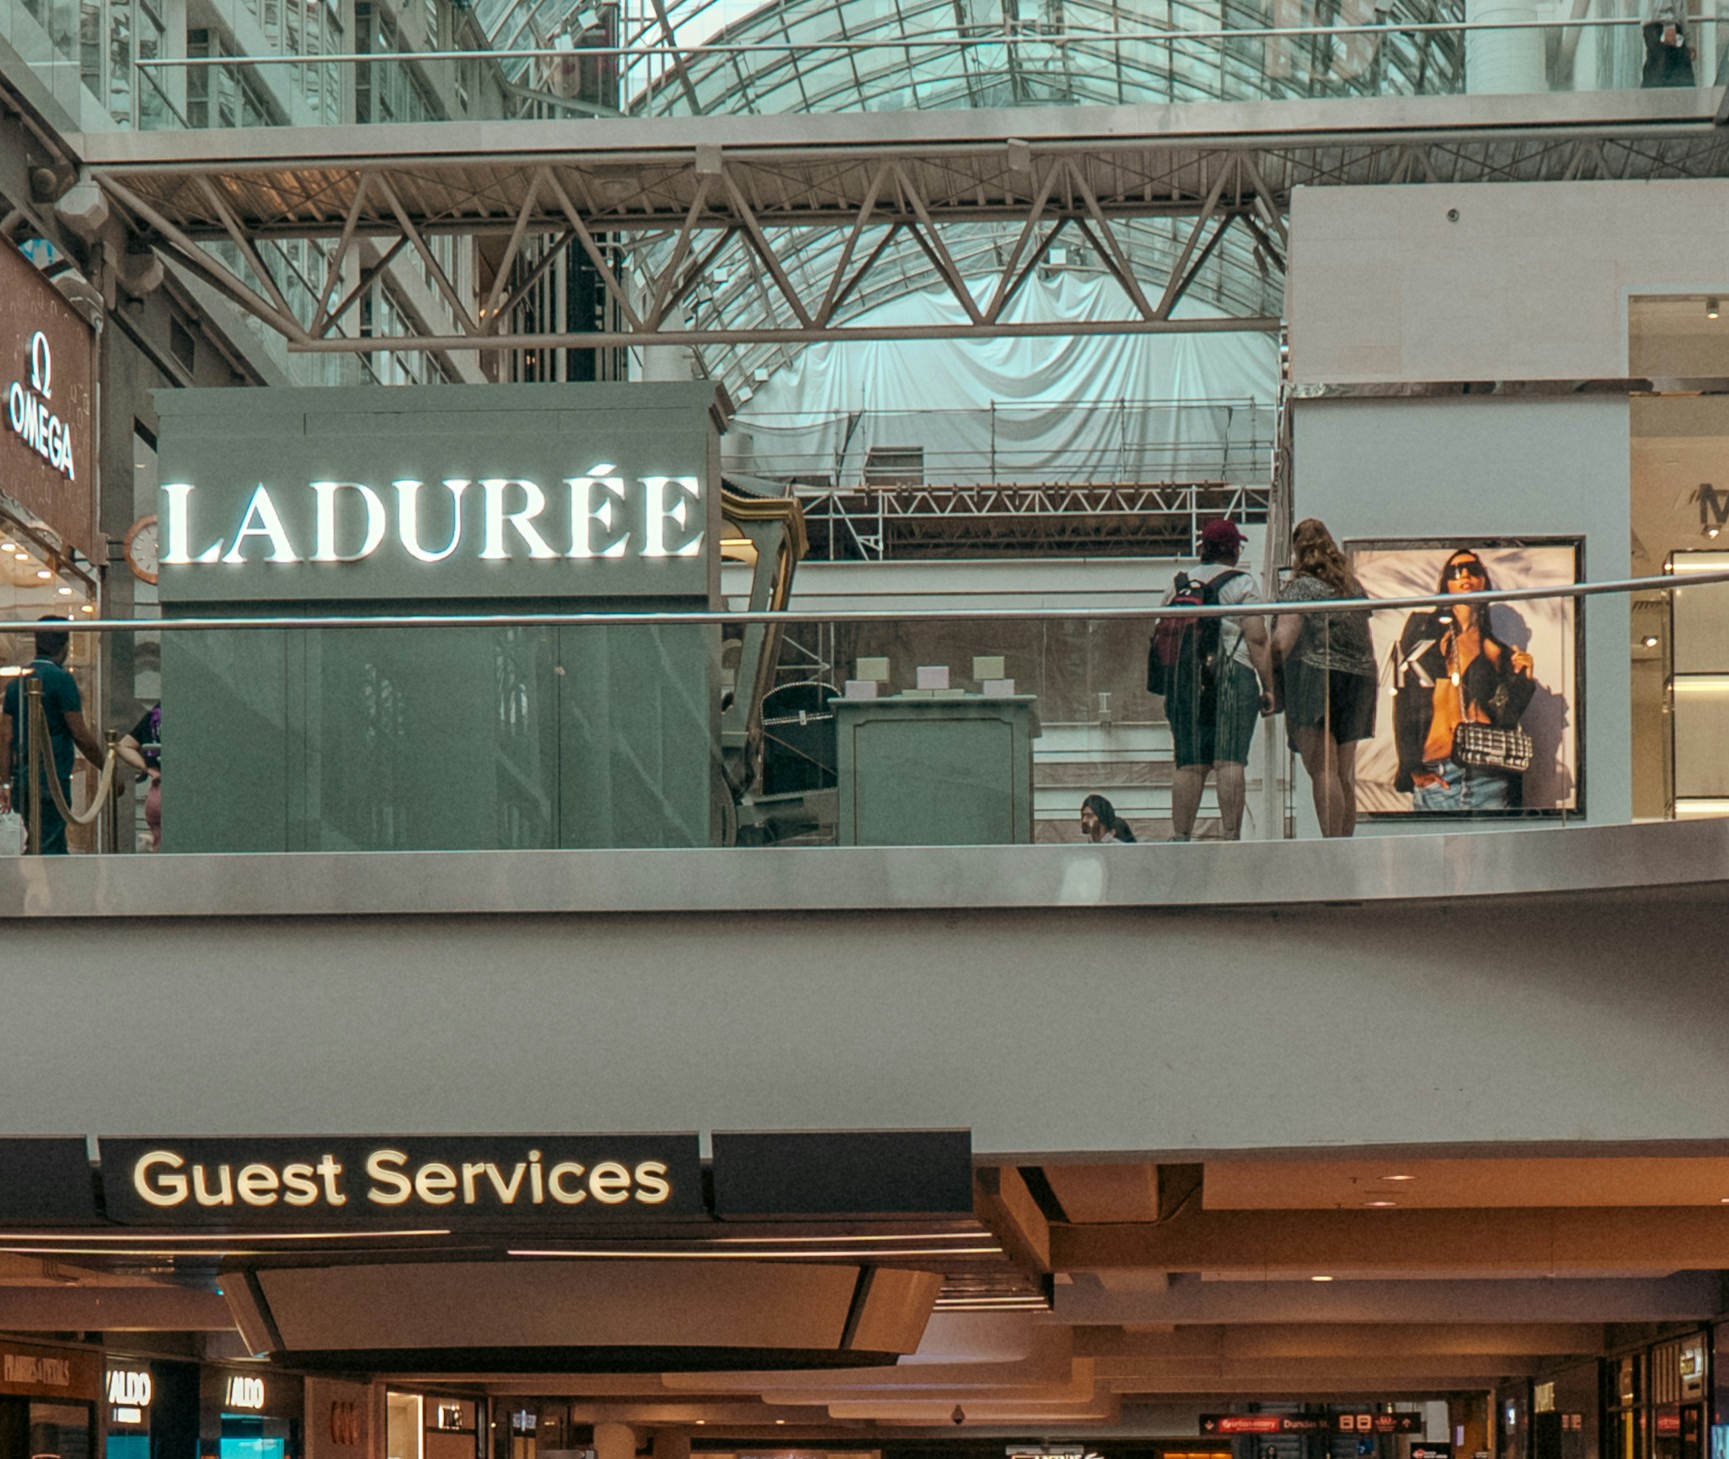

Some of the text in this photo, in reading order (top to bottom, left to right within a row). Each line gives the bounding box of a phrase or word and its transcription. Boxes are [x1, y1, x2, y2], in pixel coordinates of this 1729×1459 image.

[8, 381, 75, 481] OMEGA
[160, 463, 707, 565] LADURÉE
[132, 1147, 671, 1208] Guest Services
[109, 1370, 151, 1407] ALDO
[230, 1376, 265, 1410] ALDO
